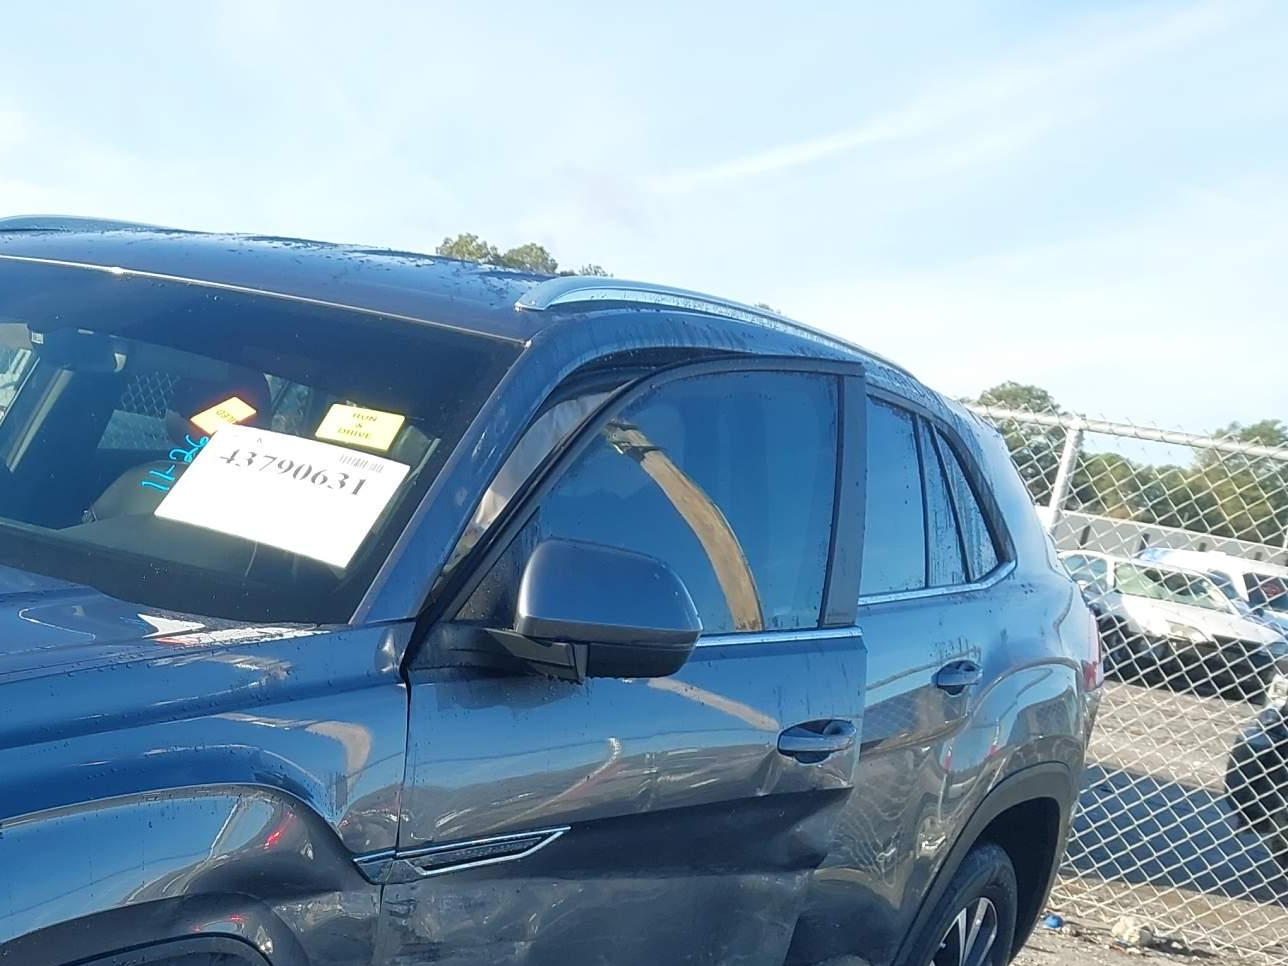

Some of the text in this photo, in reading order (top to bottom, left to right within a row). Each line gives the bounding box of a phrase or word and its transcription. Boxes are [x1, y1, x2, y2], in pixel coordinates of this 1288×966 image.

[352, 412, 378, 422] RUN
[337, 427, 371, 439] DRIVE
[219, 448, 367, 496] 43790631
